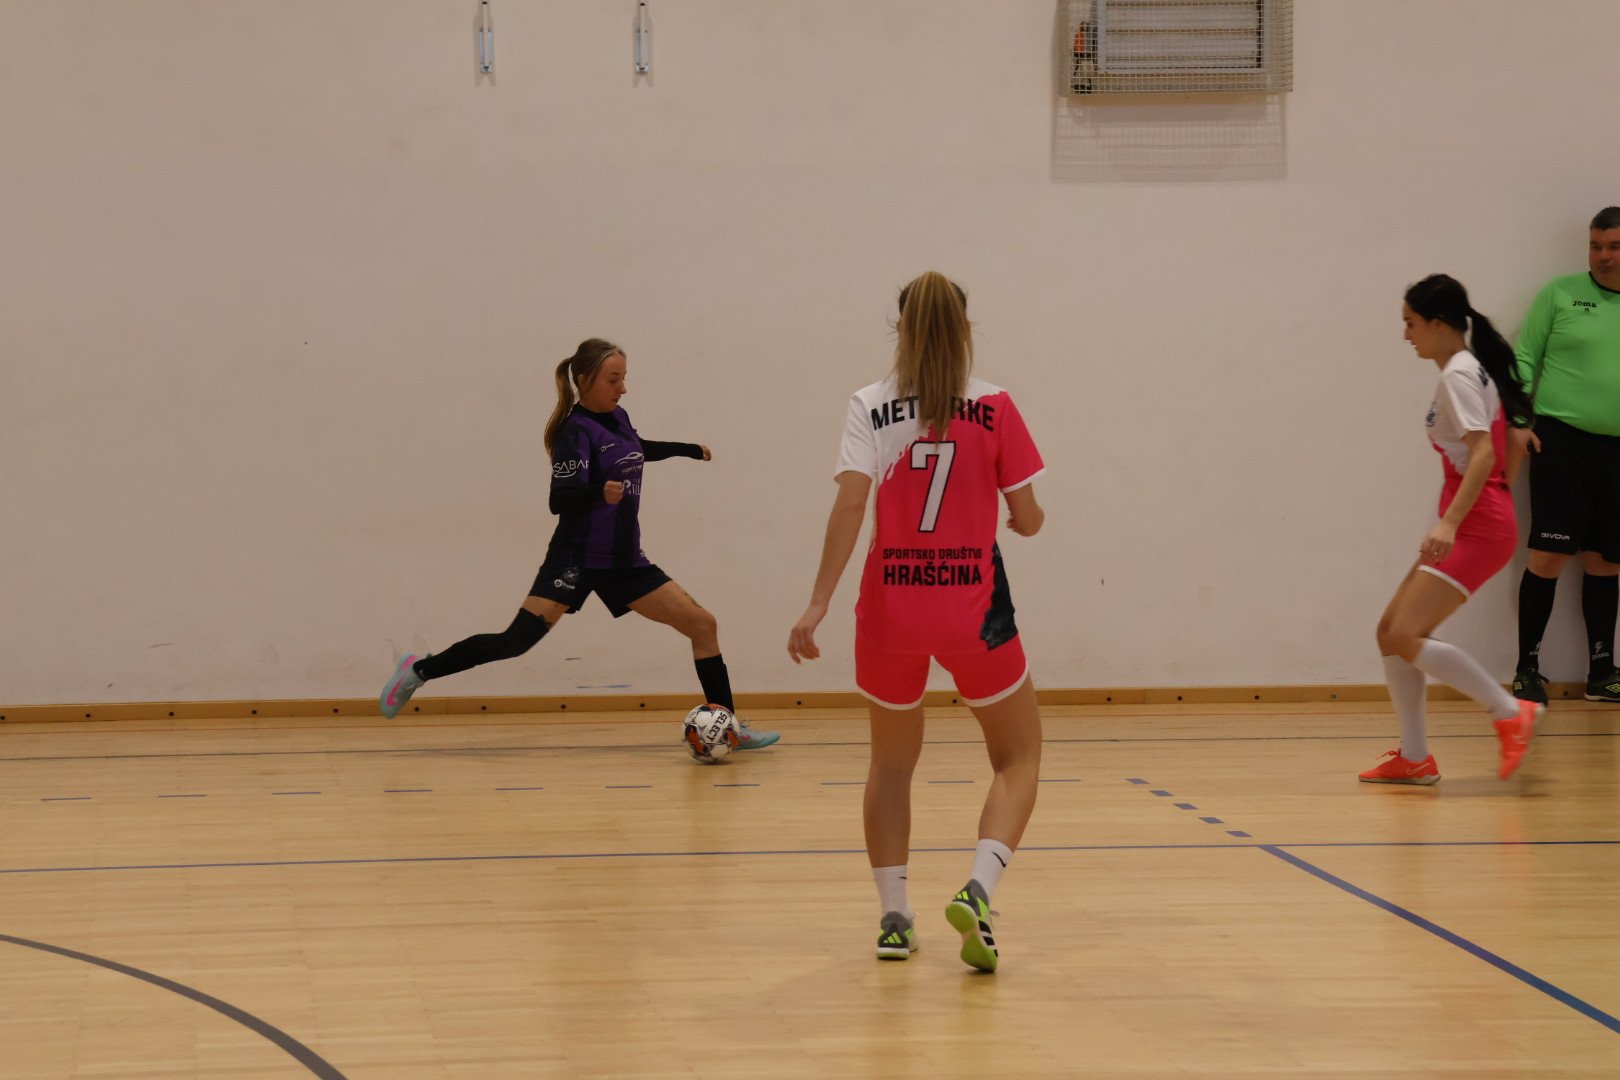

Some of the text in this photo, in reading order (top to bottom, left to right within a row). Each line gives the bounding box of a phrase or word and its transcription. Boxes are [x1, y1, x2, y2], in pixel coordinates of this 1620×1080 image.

[871, 396, 994, 431] METRKE
[910, 441, 955, 533] 7
[883, 548, 935, 559] SPORTSKO
[884, 561, 982, 585] HRAŠĆINA
[706, 712, 728, 741] SELECT
